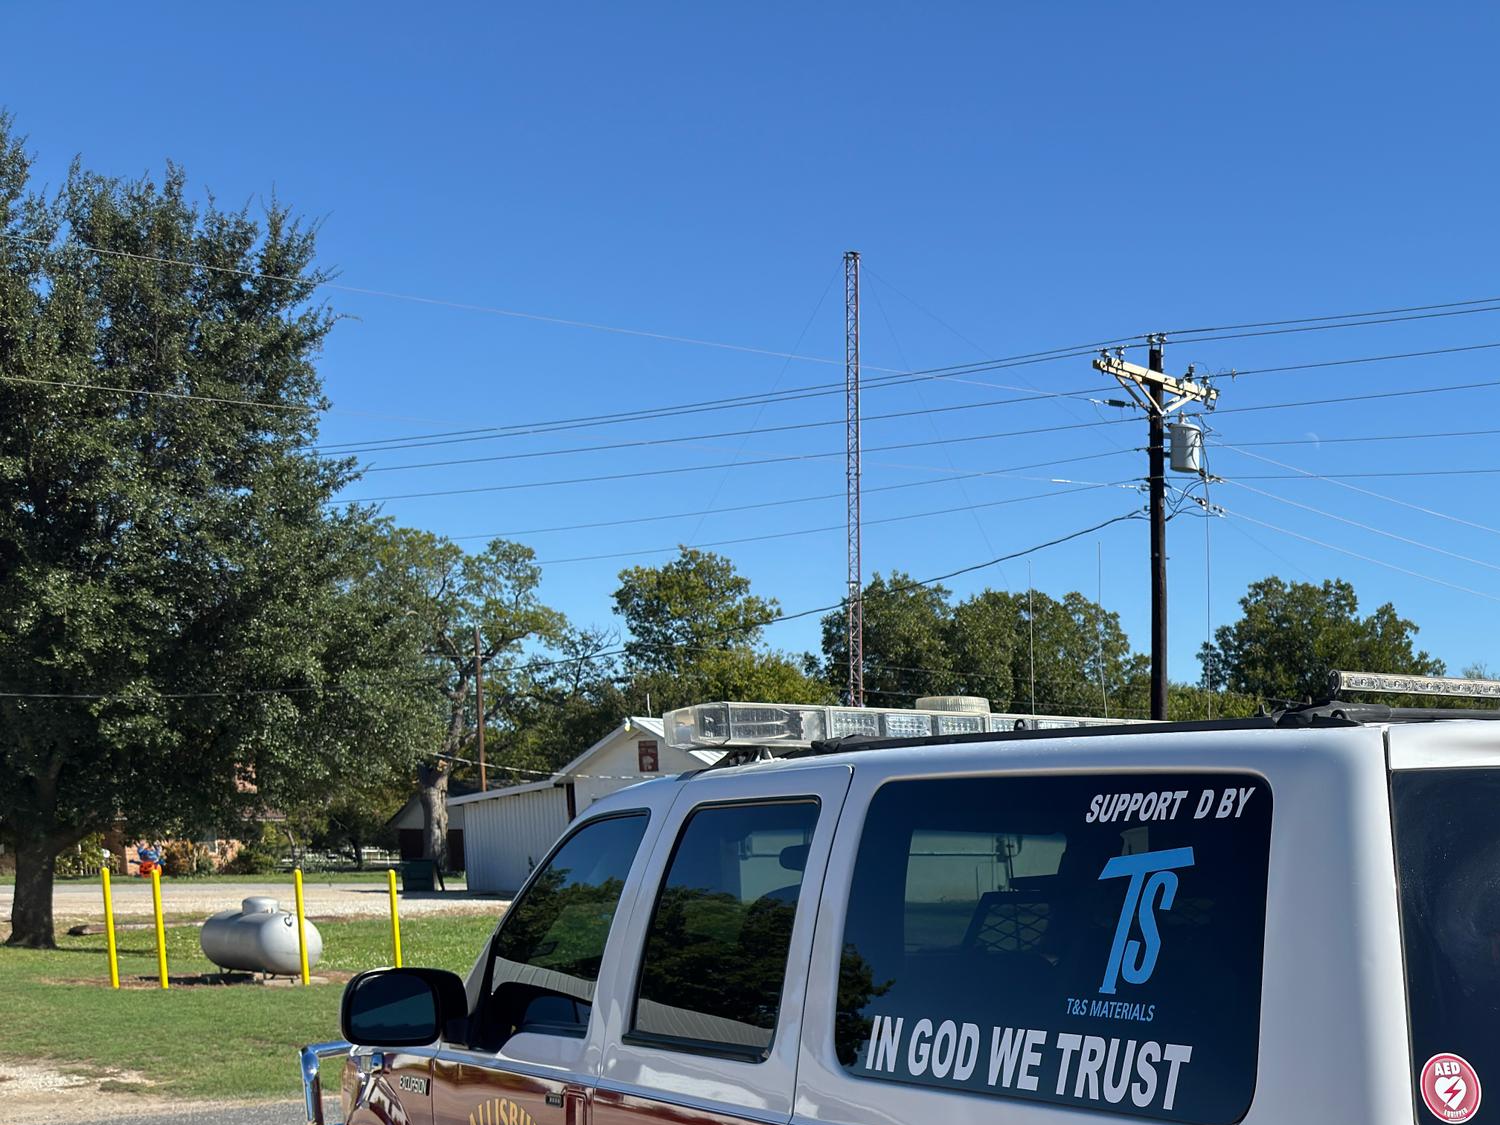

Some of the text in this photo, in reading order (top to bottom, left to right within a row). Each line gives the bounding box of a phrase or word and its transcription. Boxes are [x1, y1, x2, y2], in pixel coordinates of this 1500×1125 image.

[1216, 787, 1256, 819] BY
[1098, 846, 1195, 995] TS
[1066, 998, 1156, 1022] T&S MATERIALS
[865, 1015, 1192, 1110] IN GOD WE TRUST
[1434, 1061, 1461, 1076] AED
